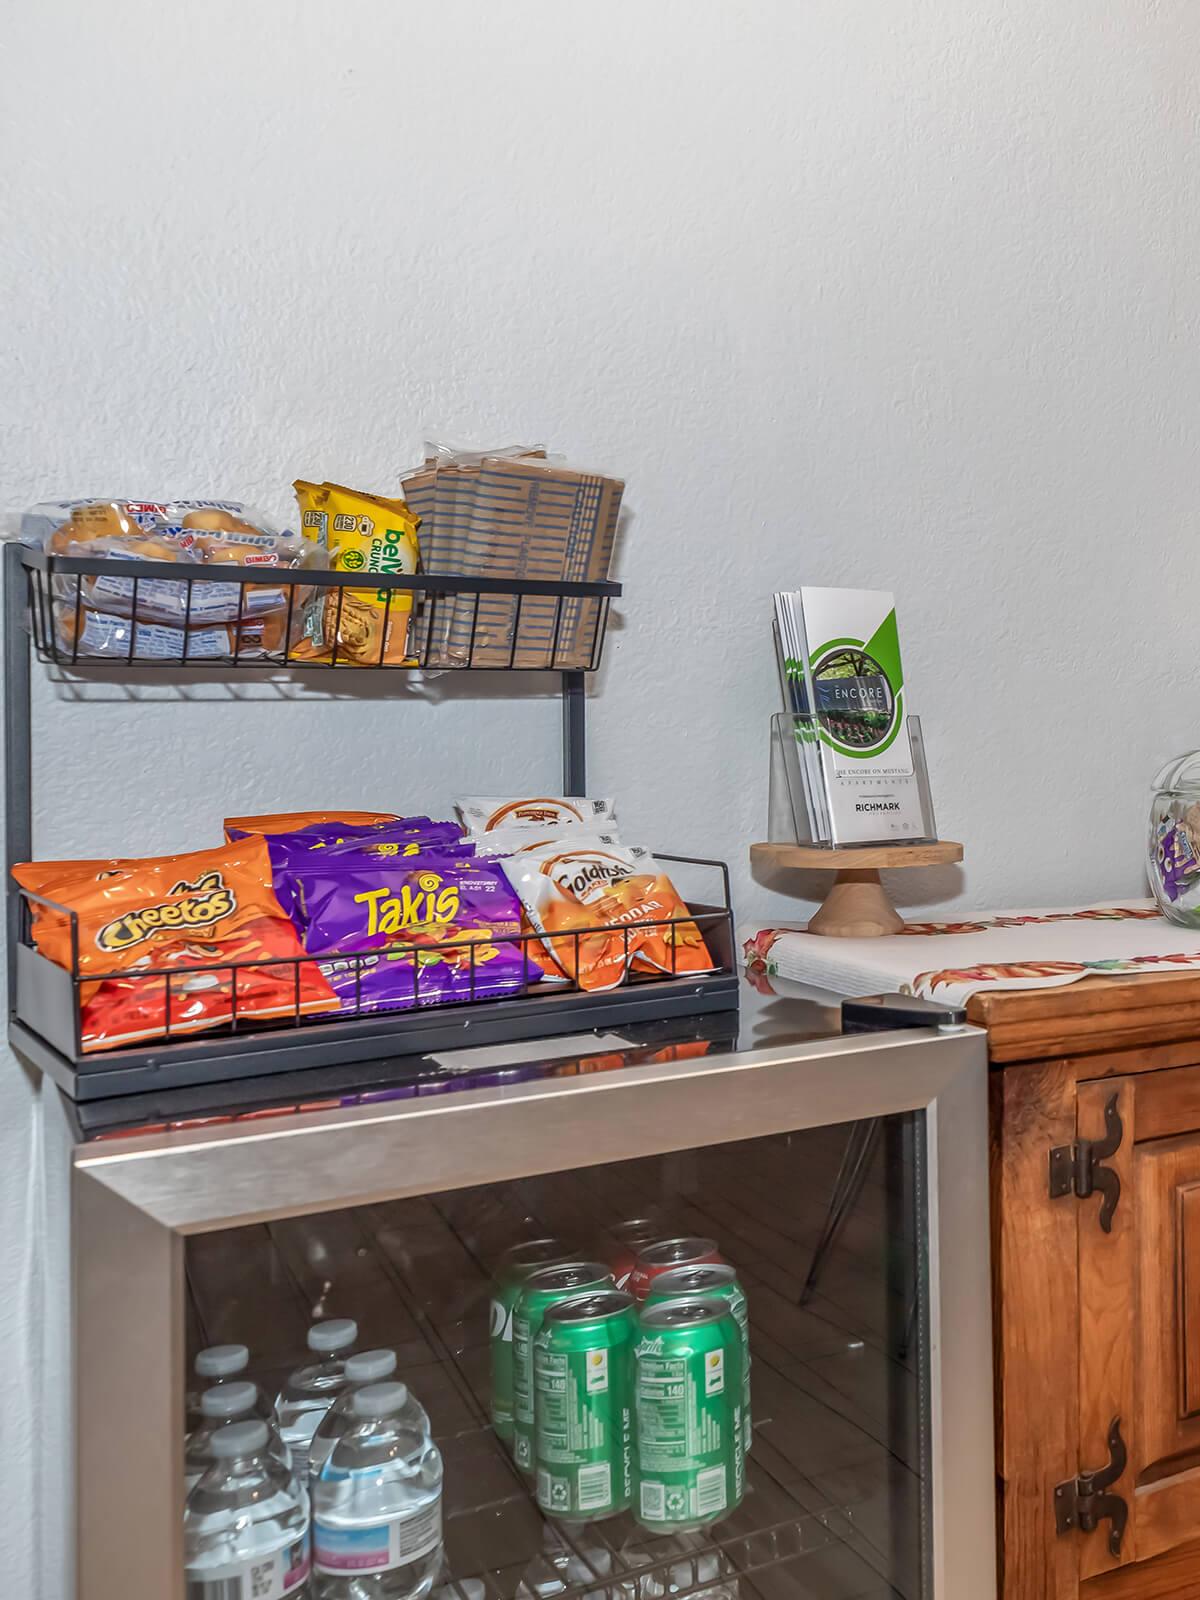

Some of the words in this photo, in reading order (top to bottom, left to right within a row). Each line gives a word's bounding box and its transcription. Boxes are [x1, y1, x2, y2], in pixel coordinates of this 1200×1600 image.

[344, 515, 355, 531] 230
[835, 687, 883, 699] ENCORE
[855, 802, 901, 812] RICHMARK
[558, 865, 633, 895] Goldfish
[354, 873, 460, 937] Takis
[99, 889, 232, 950] Cheetos
[667, 1384, 684, 1396] 140
